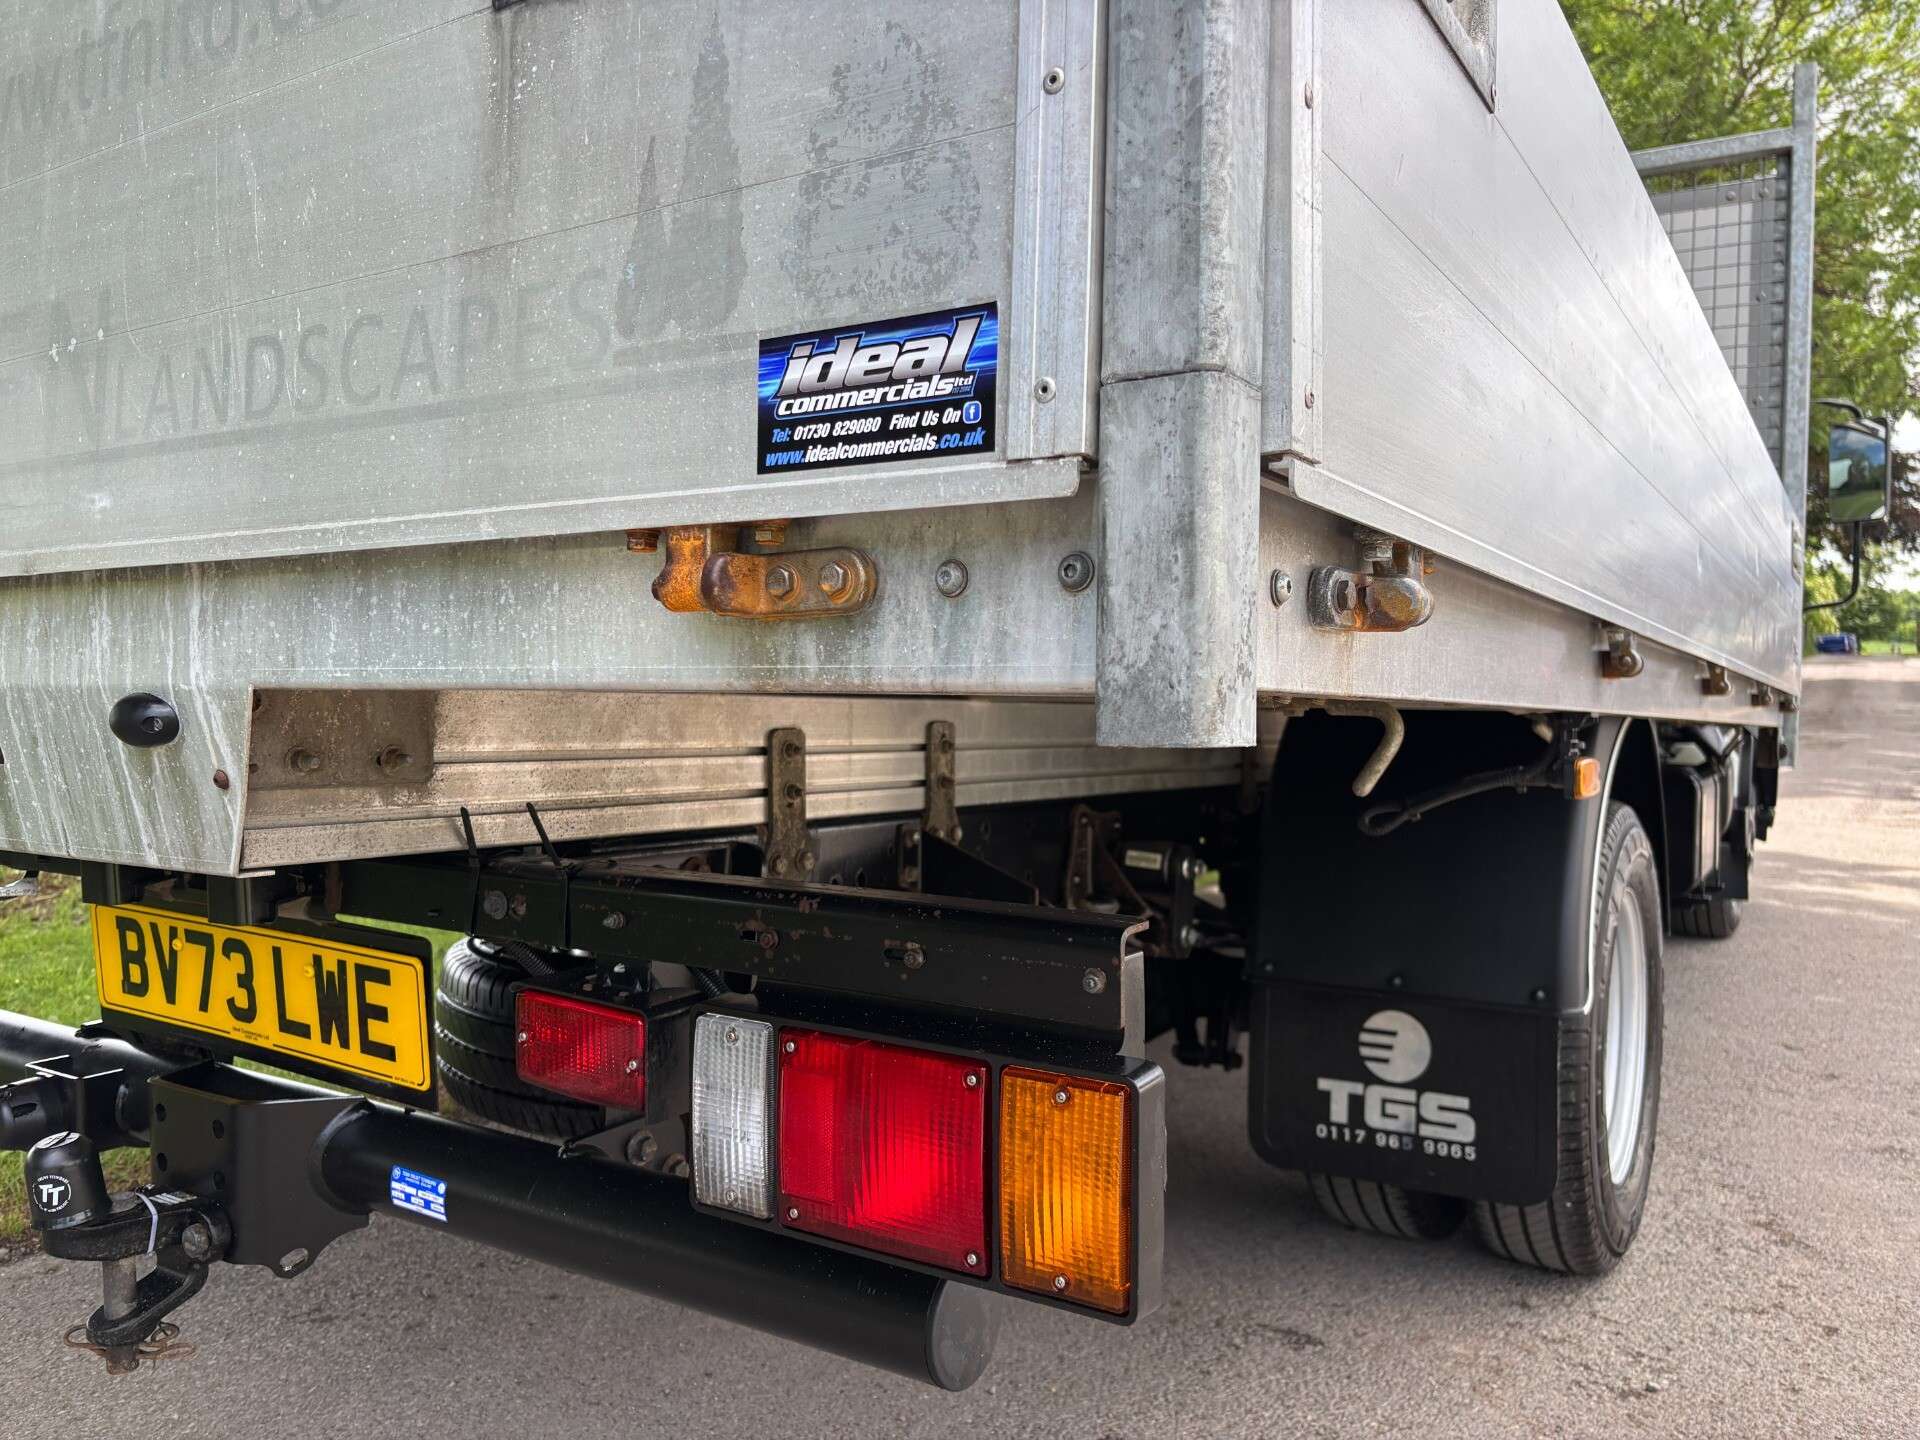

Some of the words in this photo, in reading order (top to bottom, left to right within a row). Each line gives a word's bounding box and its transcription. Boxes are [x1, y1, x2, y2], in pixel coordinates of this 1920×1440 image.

[114, 267, 612, 440] LANDSCAPES
[778, 316, 983, 396] ideal
[778, 374, 955, 415] commercials
[954, 375, 973, 386] ltd
[772, 428, 791, 443] Tel:
[793, 423, 831, 440] 01730
[832, 417, 882, 436] 829080
[889, 412, 920, 430] Find
[921, 410, 940, 427] Us
[942, 408, 961, 424] On
[765, 427, 986, 467] www.idealcommercials.co.uk
[114, 915, 257, 1024] BV73
[272, 945, 397, 1063] LWE
[1316, 1077, 1476, 1144] TGS
[1316, 1123, 1366, 1143] 0117
[1423, 1139, 1476, 1161] 9965
[38, 1183, 65, 1206] TT
